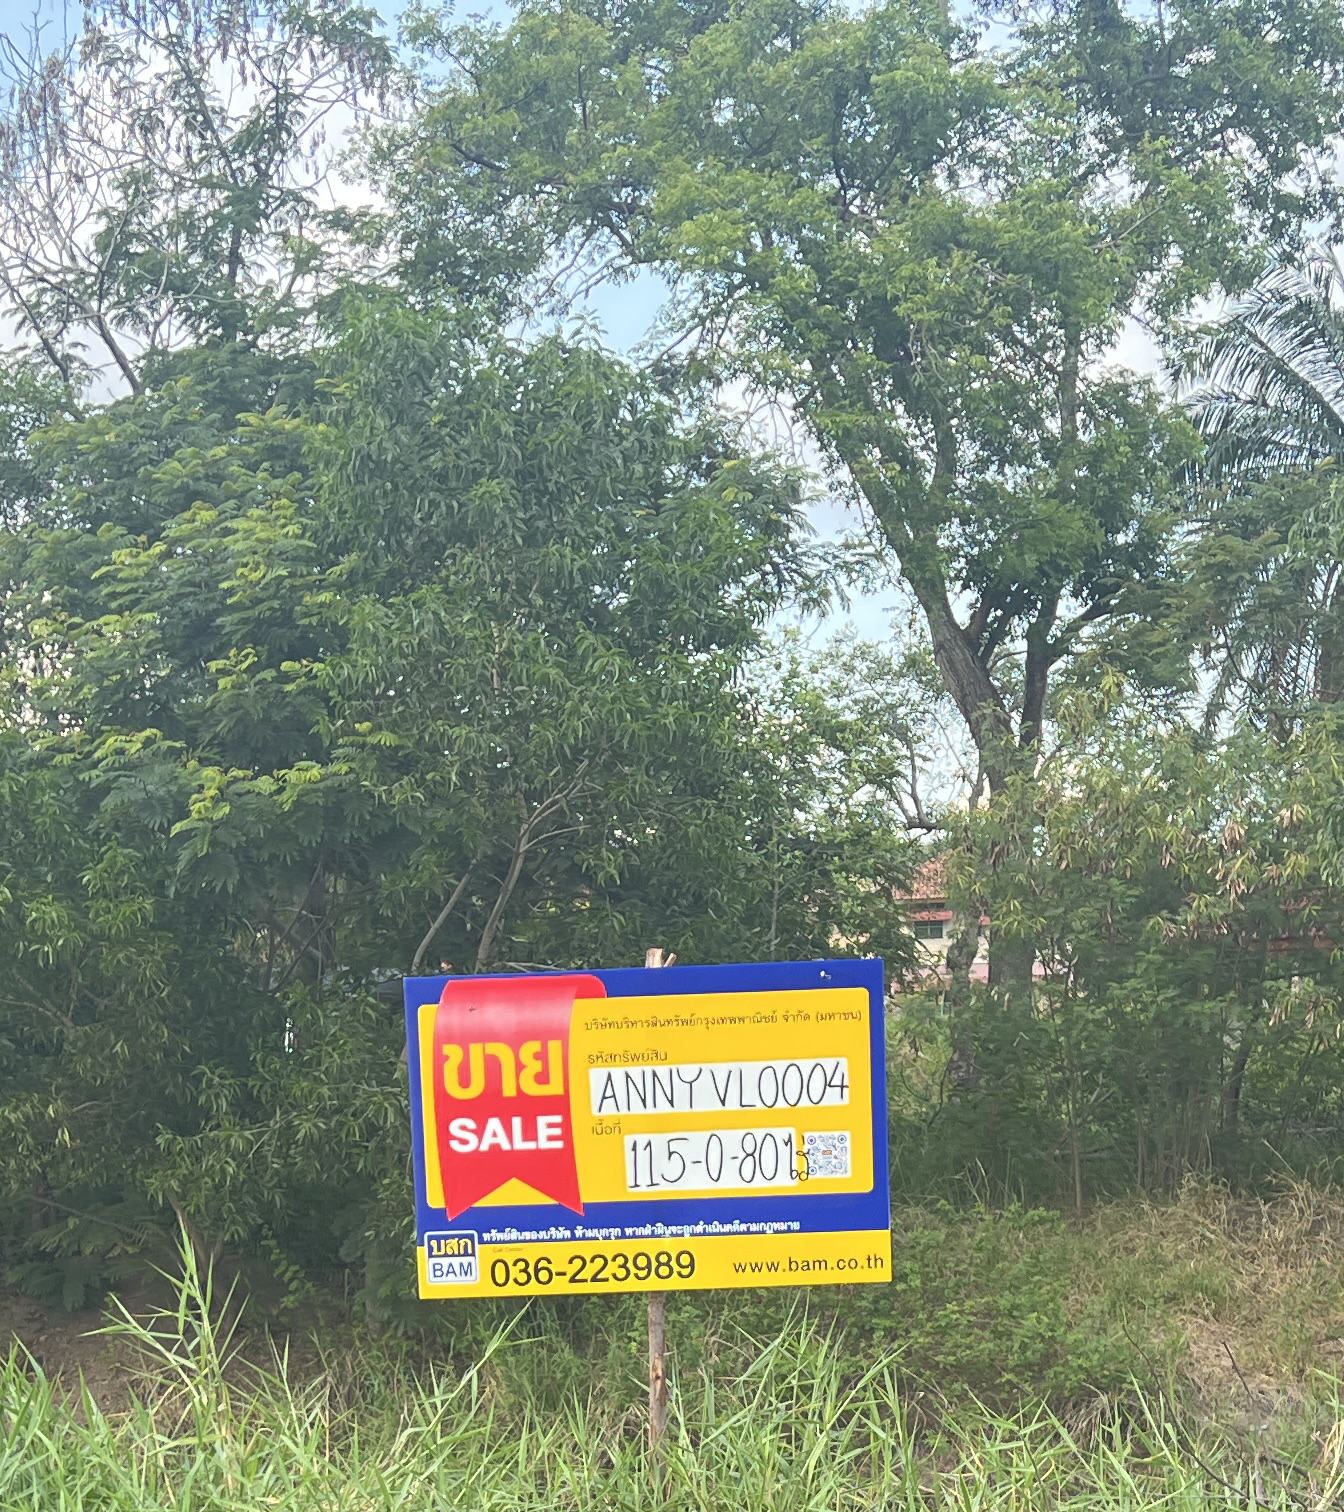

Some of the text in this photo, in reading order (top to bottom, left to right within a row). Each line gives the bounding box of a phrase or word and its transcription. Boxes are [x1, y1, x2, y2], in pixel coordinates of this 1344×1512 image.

[782, 1010, 811, 1023] จำกัด
[816, 1009, 863, 1023] (มหาชน)
[588, 1048, 668, 1064] รหัสทรัพย์สิน
[442, 1039, 565, 1100] ขาย
[448, 1114, 565, 1153] SALE
[591, 1118, 622, 1136] เนื้อที่
[574, 1225, 622, 1241] ห้ามบุกรุก
[430, 1236, 473, 1256] บสก
[432, 1260, 473, 1279] BAM
[490, 1250, 696, 1288] 036-223989
[733, 1253, 884, 1274] www.bam.co.th
